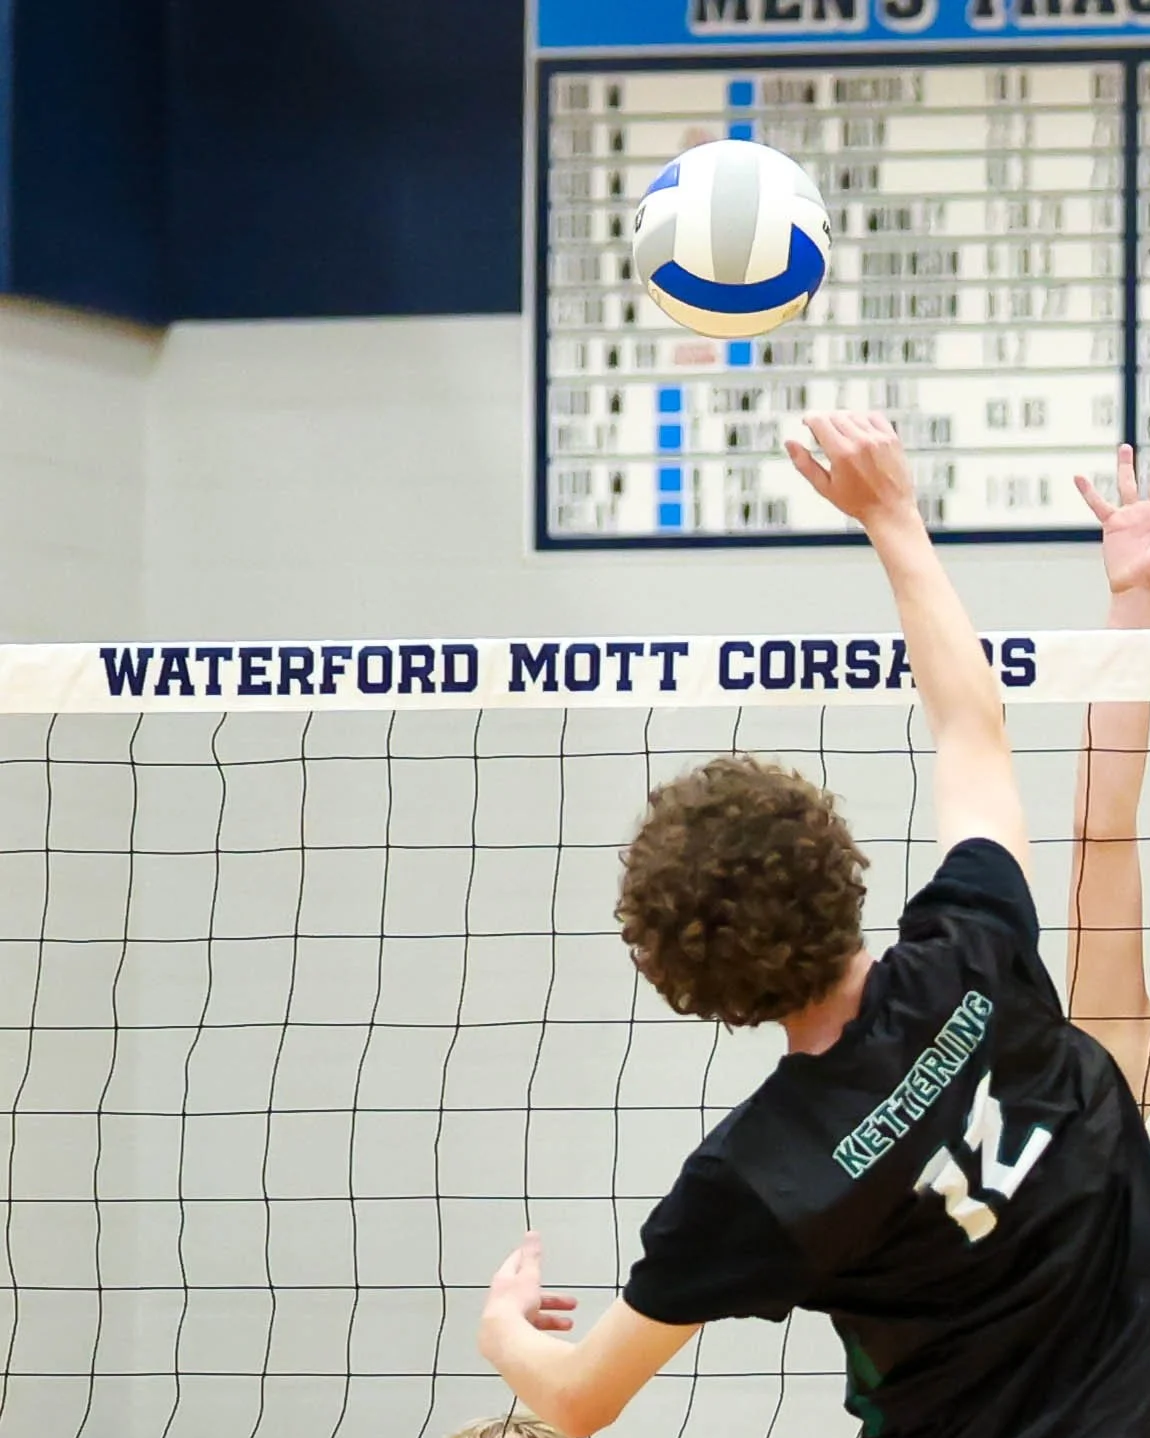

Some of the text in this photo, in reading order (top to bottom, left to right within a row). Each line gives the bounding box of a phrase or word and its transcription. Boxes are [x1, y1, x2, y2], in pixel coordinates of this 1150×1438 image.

[100, 637, 1037, 697] WATERFORD MOTT CORSAS
[832, 990, 993, 1179] KETTERING
